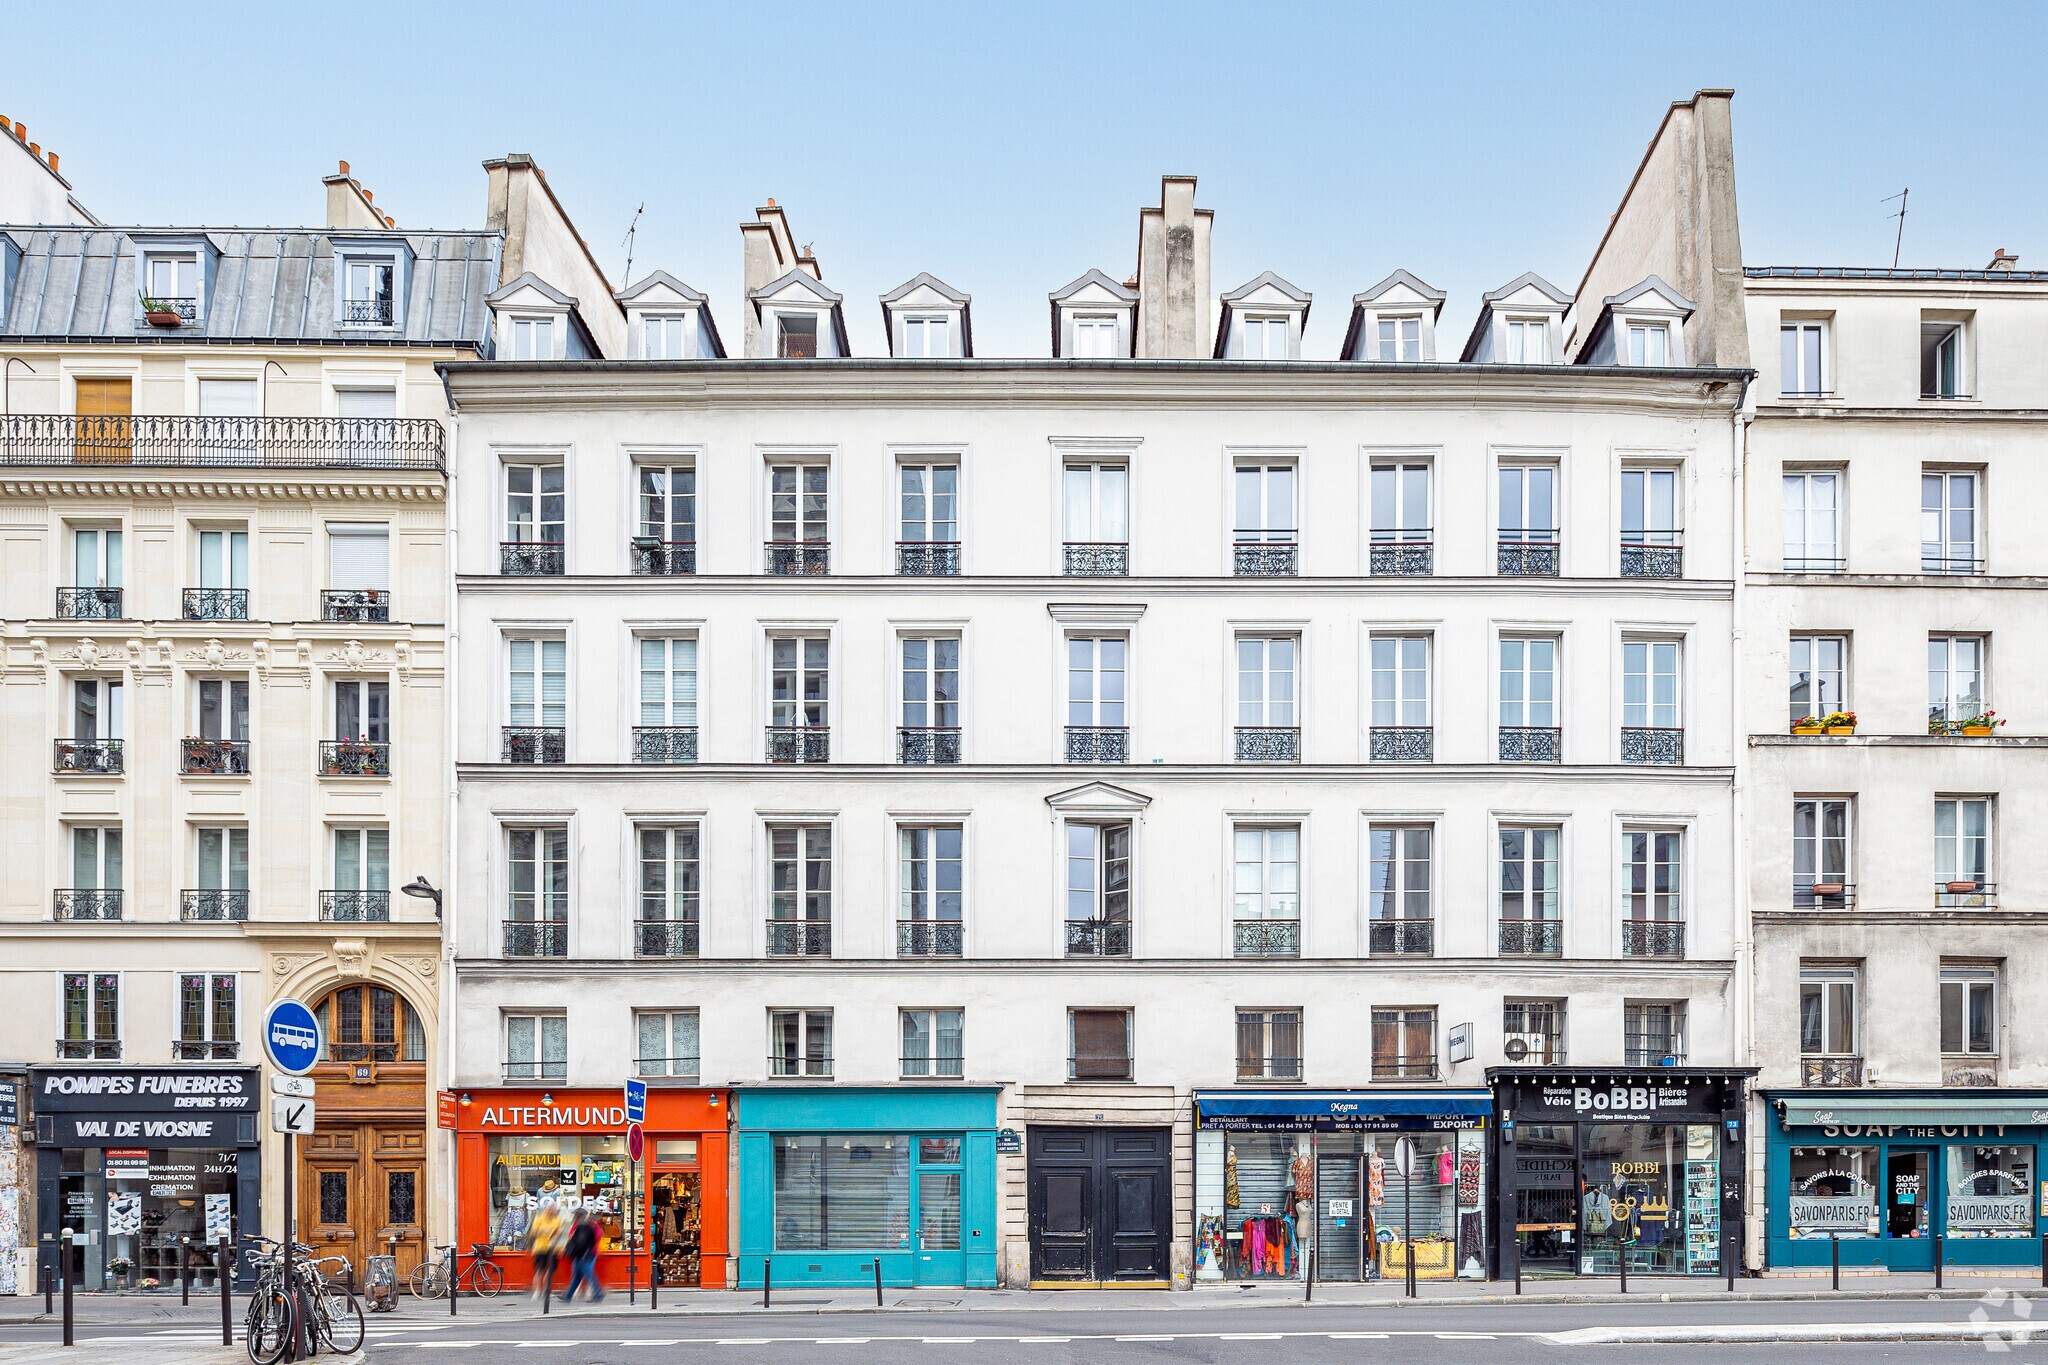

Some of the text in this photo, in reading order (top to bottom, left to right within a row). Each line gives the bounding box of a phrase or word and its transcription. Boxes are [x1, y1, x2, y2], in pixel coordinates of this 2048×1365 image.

[356, 1069, 368, 1077] 69
[44, 1075, 243, 1094] POMPES FUNEBRES
[1543, 1087, 1572, 1096] Réparation
[1659, 1087, 1688, 1096] Bières
[174, 1097, 249, 1108] DEPUIS 1997
[1543, 1096, 1572, 1106] Vélo
[1574, 1087, 1657, 1110] BoBBi
[1659, 1097, 1688, 1106] Artisanales
[1331, 1102, 1358, 1112] Megna
[481, 1107, 631, 1125] ALTERMUND
[1813, 1110, 1833, 1124] Soap
[76, 1121, 213, 1137] VAL DE VIOSNE
[1433, 1121, 1475, 1129] EXPORT
[1824, 1125, 2005, 1137] SOAP THE CITY
[496, 1154, 579, 1165] ALTERMUNDI
[1611, 1161, 1660, 1174] BOBBI
[1799, 1170, 1828, 1190] SAVONS
[1828, 1168, 1834, 1176] À
[1846, 1171, 1871, 1190] COUPE
[1895, 1174, 1920, 1182] SOAP
[1957, 1169, 1988, 1189] BOUGIES
[1895, 1187, 1920, 1195] CITY
[526, 1195, 608, 1211] SOLDES
[1794, 1205, 1870, 1221] SAVONPARIS.FR
[1950, 1205, 2026, 1221] SAVONPARIS.FR
